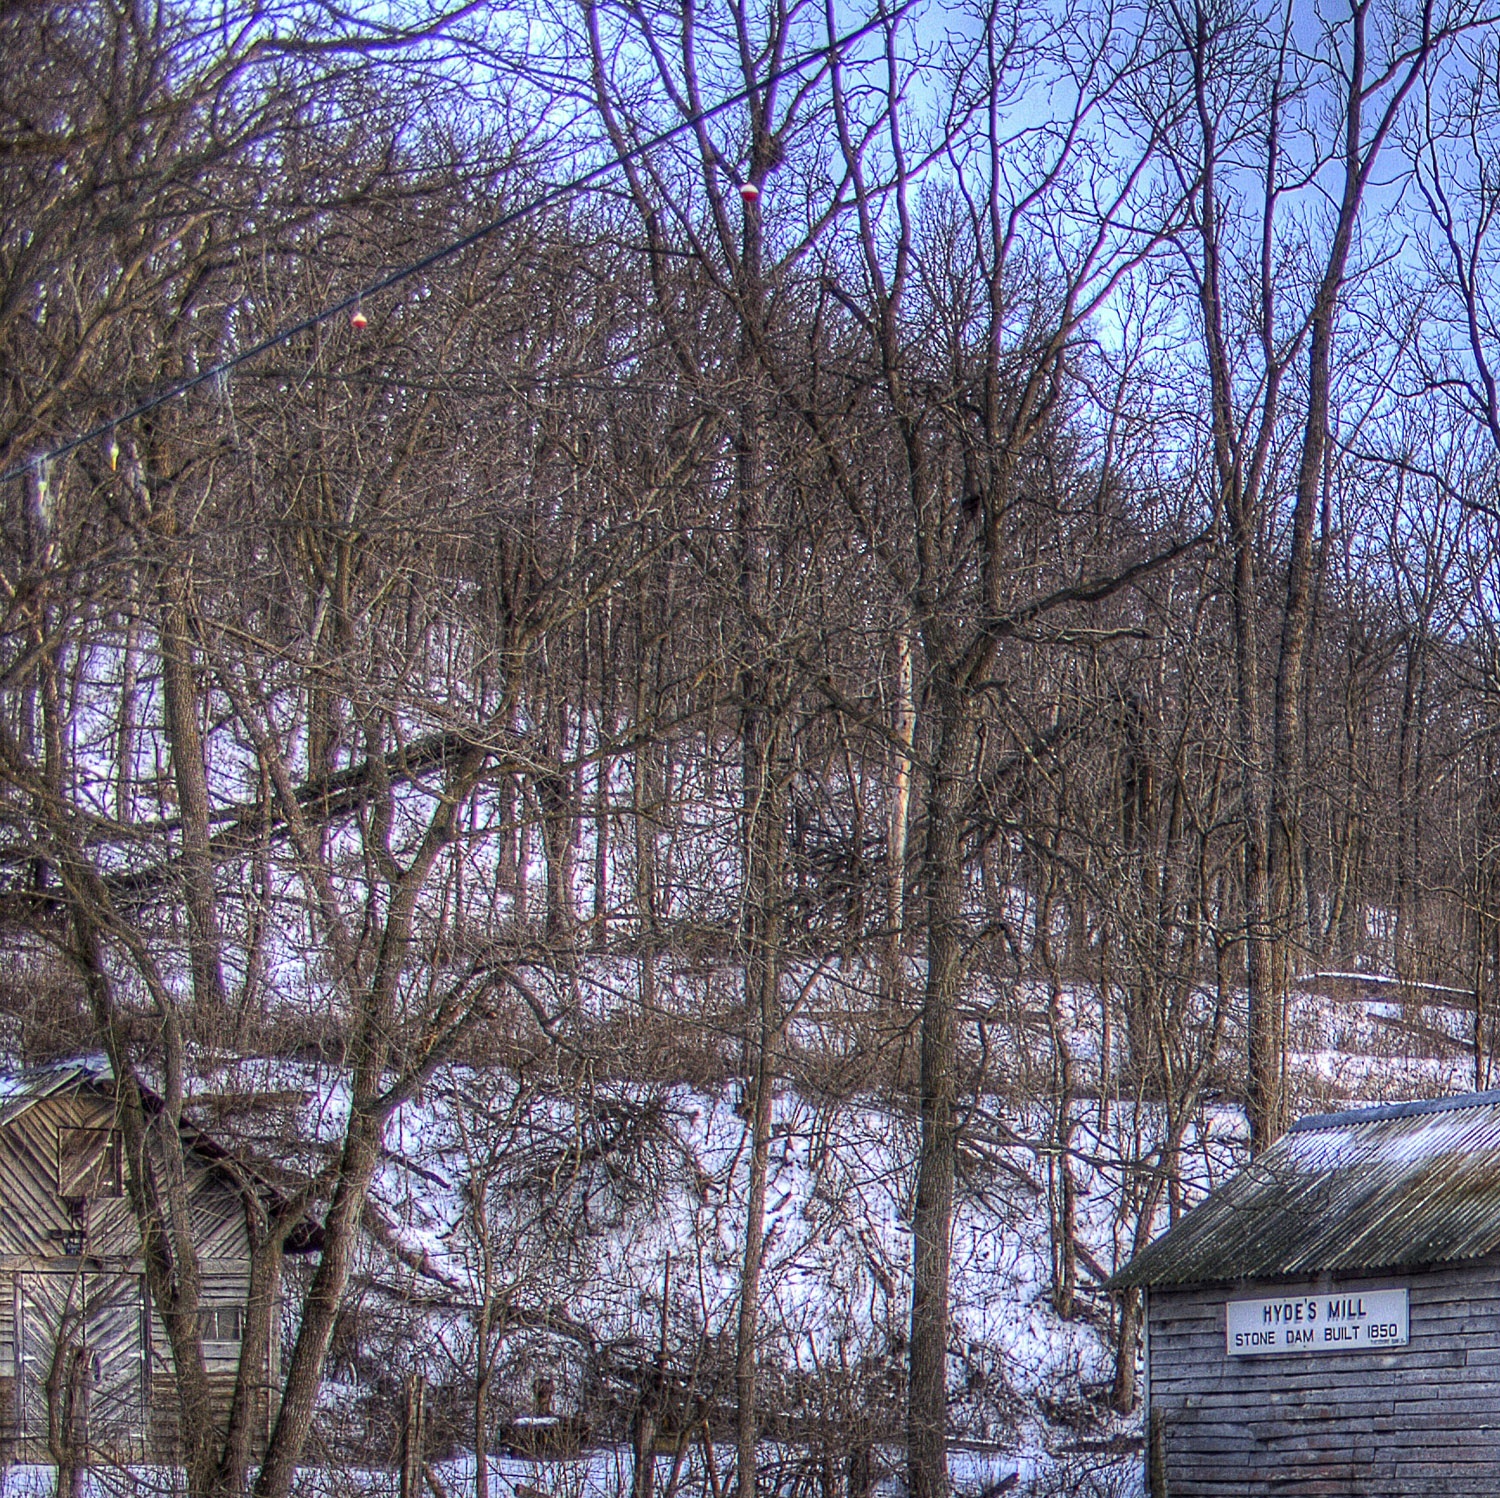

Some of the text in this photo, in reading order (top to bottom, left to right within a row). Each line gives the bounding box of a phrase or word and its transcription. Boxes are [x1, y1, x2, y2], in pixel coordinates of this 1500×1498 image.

[1264, 1298, 1367, 1323] HYDE'S MILL
[1235, 1323, 1398, 1347] STONE DAM BUILT 1850
